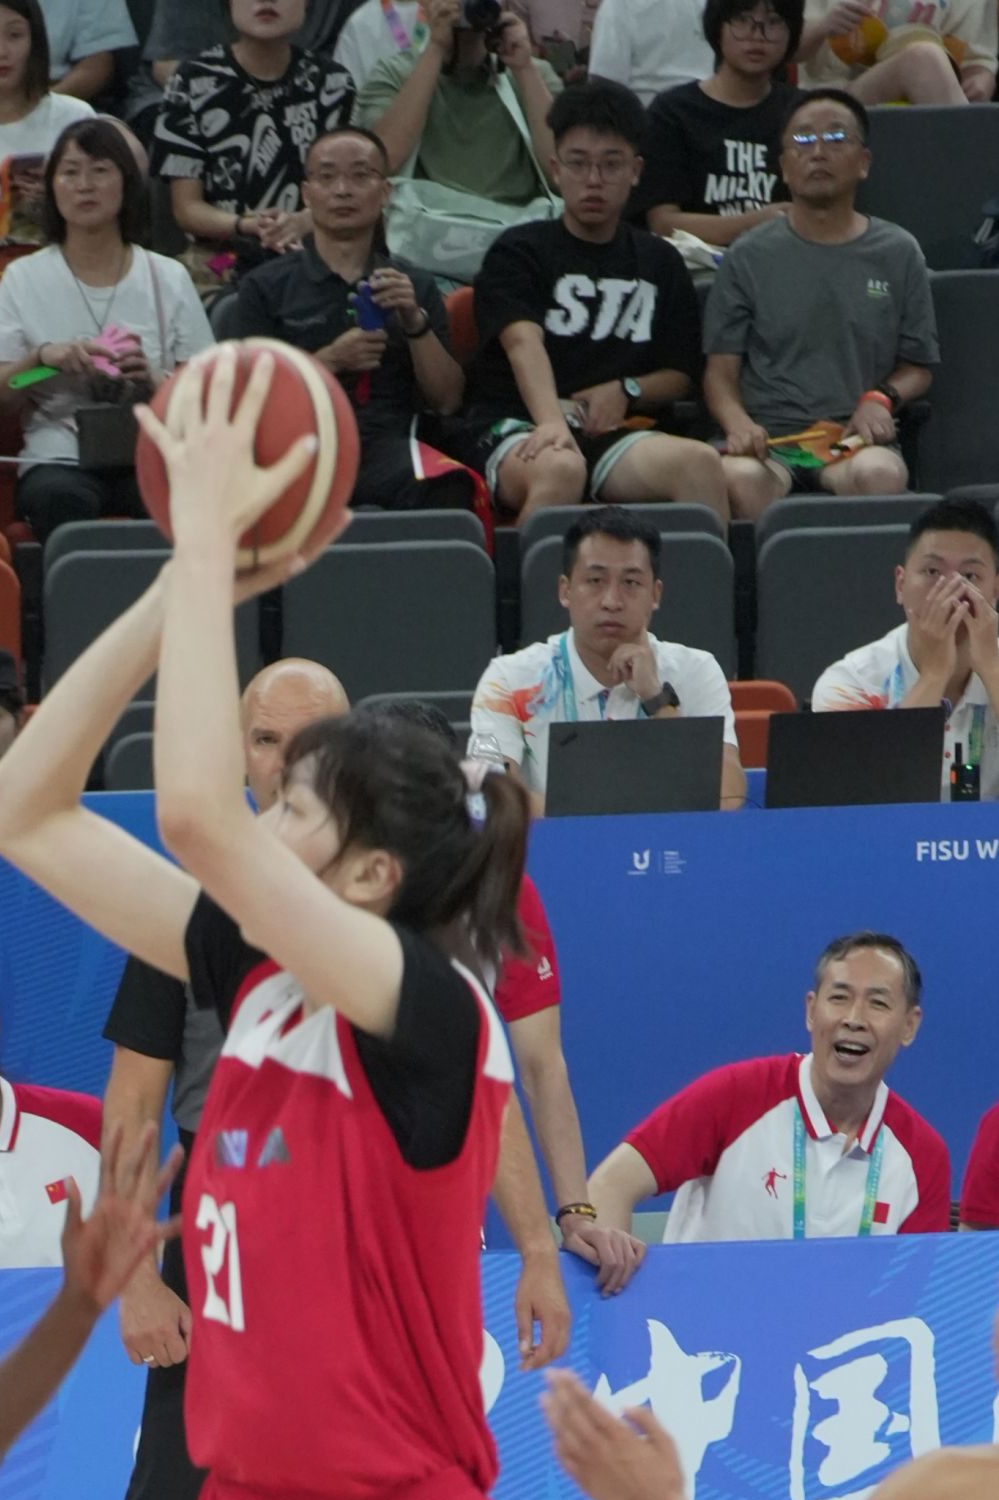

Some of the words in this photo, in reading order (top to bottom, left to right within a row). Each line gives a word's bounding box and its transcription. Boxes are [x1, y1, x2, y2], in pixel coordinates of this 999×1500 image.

[724, 139, 768, 173] THE
[704, 171, 777, 205] MILKY
[545, 274, 658, 342] STA
[917, 840, 969, 861] FISU
[196, 1193, 245, 1332] 21
